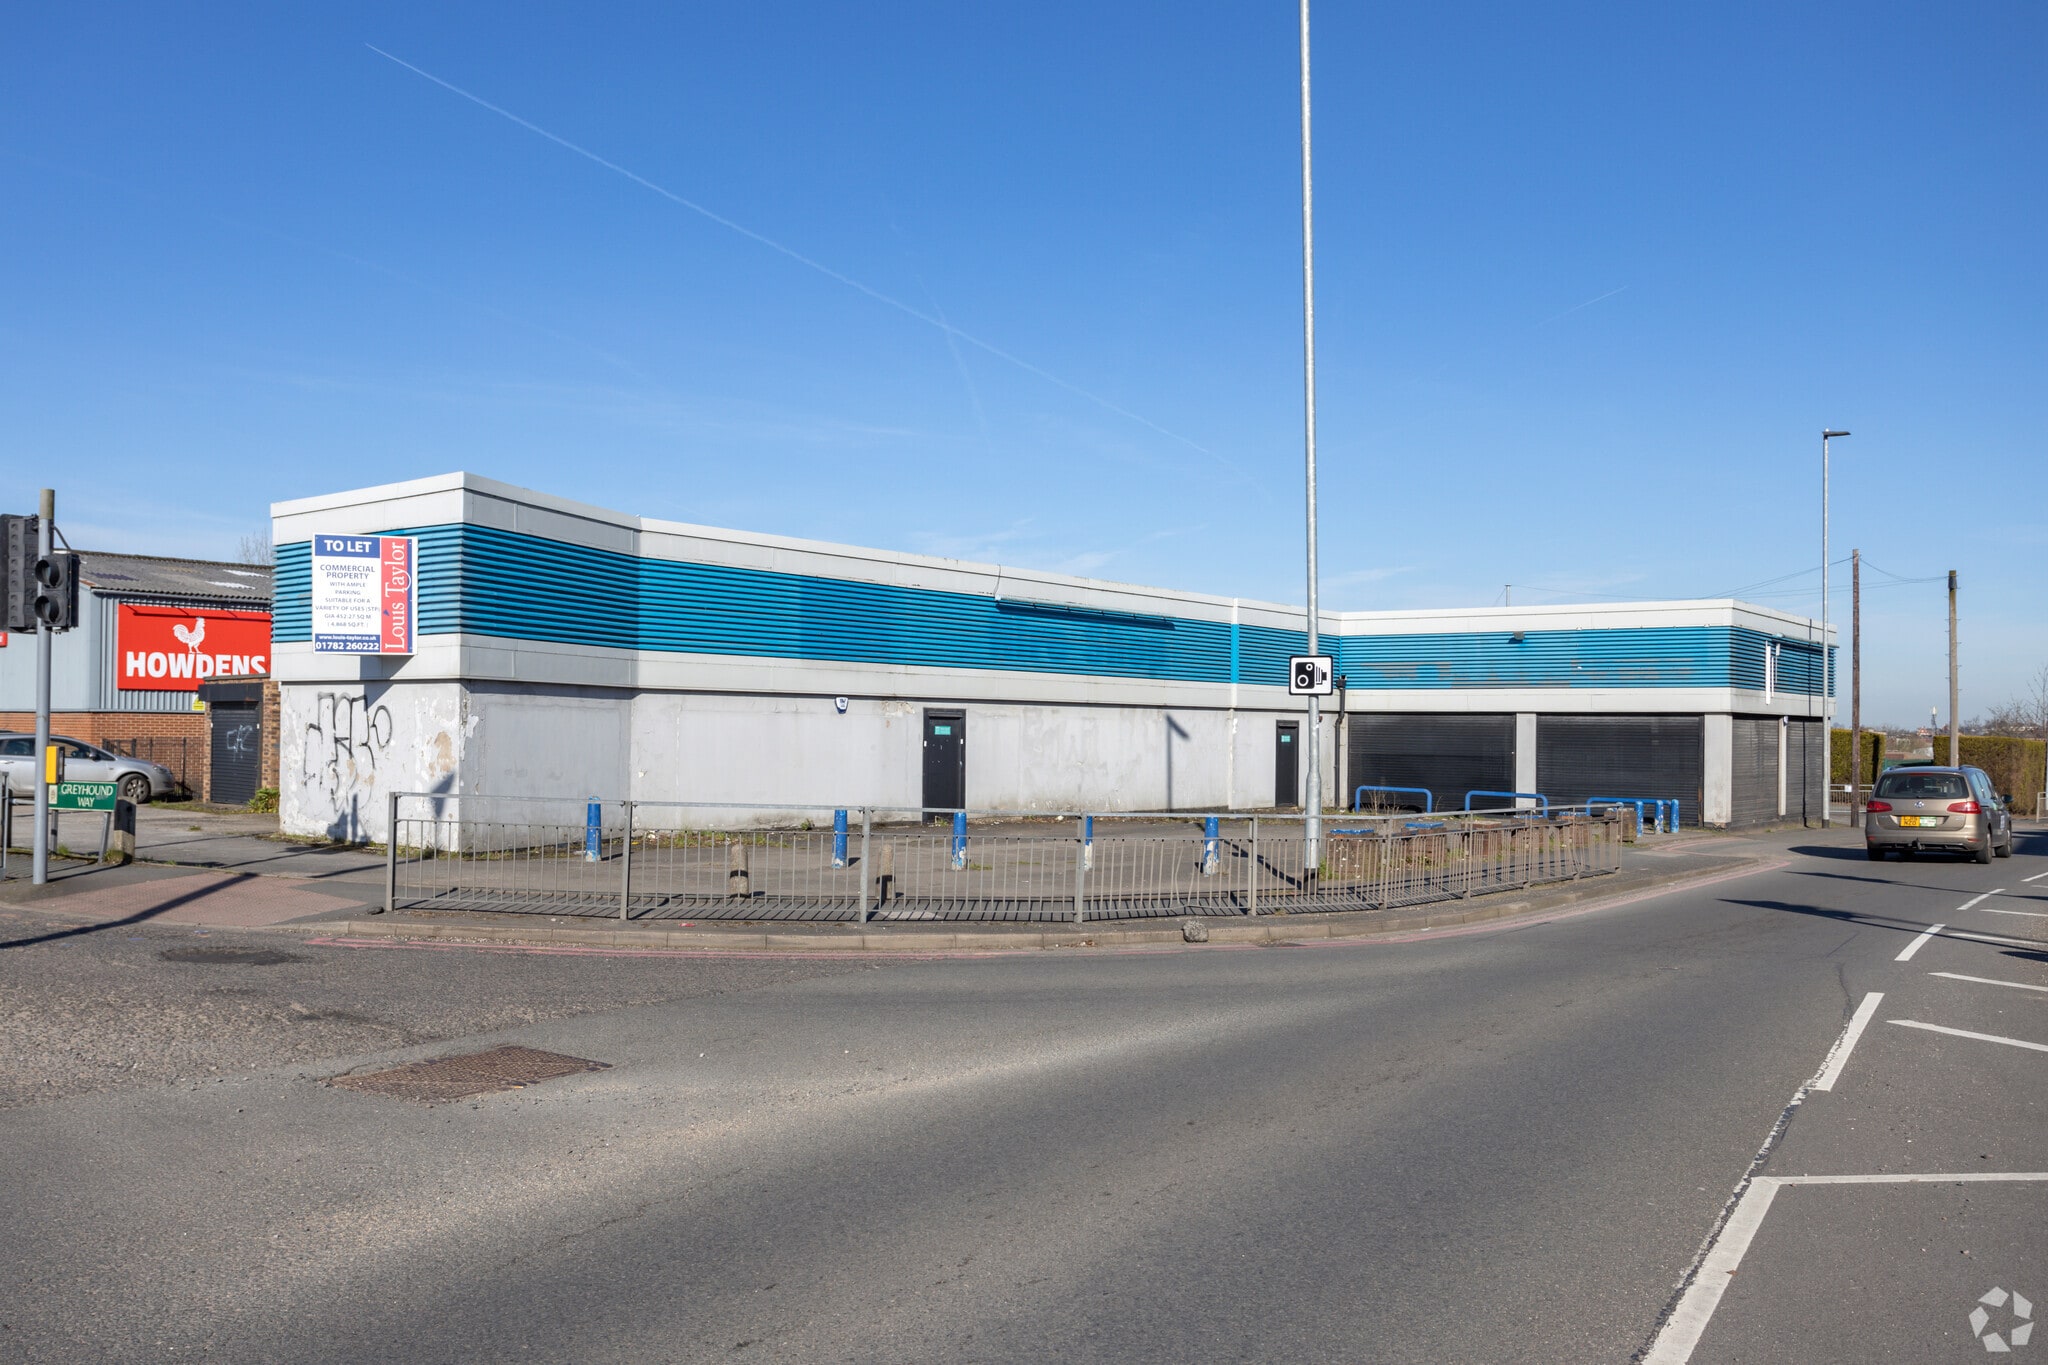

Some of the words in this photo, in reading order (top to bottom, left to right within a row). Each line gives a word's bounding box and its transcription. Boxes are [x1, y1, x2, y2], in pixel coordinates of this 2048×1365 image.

[324, 539, 344, 552] TO
[347, 540, 372, 553] LET
[320, 564, 375, 573] COMMERCIAL
[384, 542, 411, 598] Taylor
[326, 571, 369, 580] PROPERTY
[383, 602, 405, 649] Louis
[315, 641, 345, 650] 01782
[345, 642, 379, 651] 260222
[126, 651, 267, 679] HOWDENS
[61, 784, 114, 796] GREYHOUND
[77, 796, 95, 808] WAY
